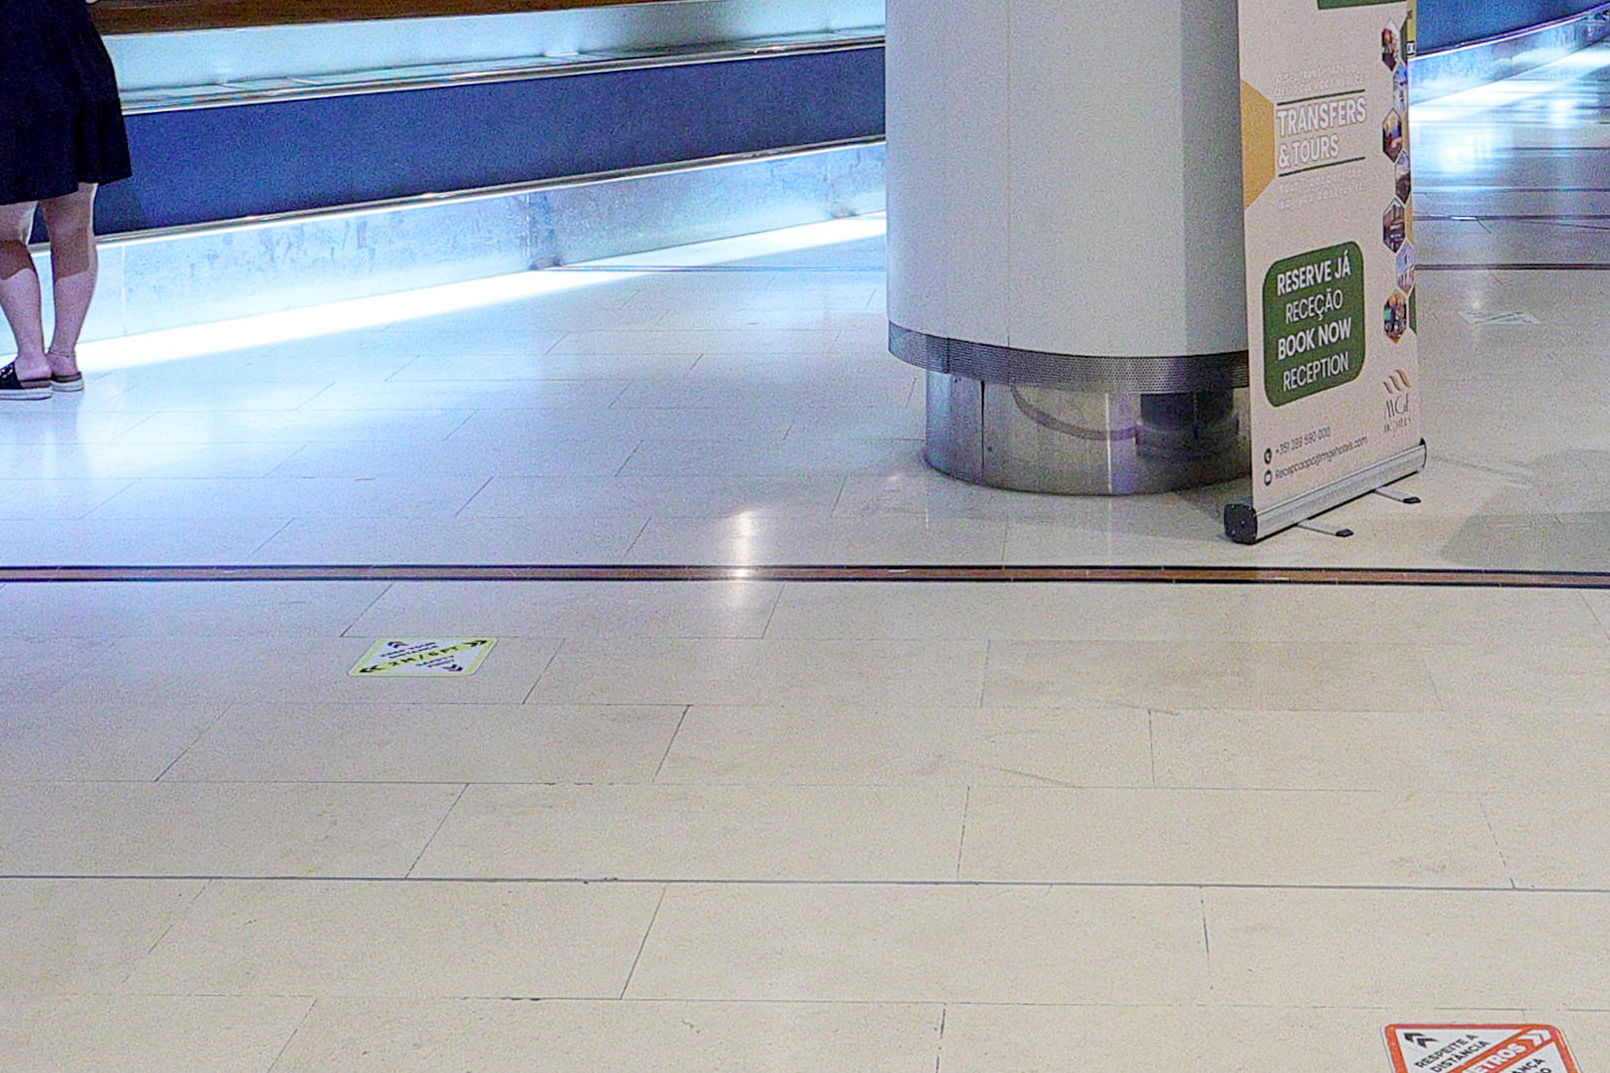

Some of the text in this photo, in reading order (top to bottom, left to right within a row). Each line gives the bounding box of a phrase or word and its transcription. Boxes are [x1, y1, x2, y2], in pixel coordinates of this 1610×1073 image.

[1276, 96, 1367, 137] TRANSFERS
[1278, 133, 1339, 168] & TOURS
[1277, 249, 1352, 296] RESERVE JÁ
[1285, 288, 1344, 324] RECEÇÃO
[1277, 317, 1352, 361] BOOK NOW
[1283, 351, 1350, 392] RECEPTION
[1414, 1033, 1480, 1069] RESPEITE A
[1430, 1040, 1491, 1073] DISTÂNCIA
